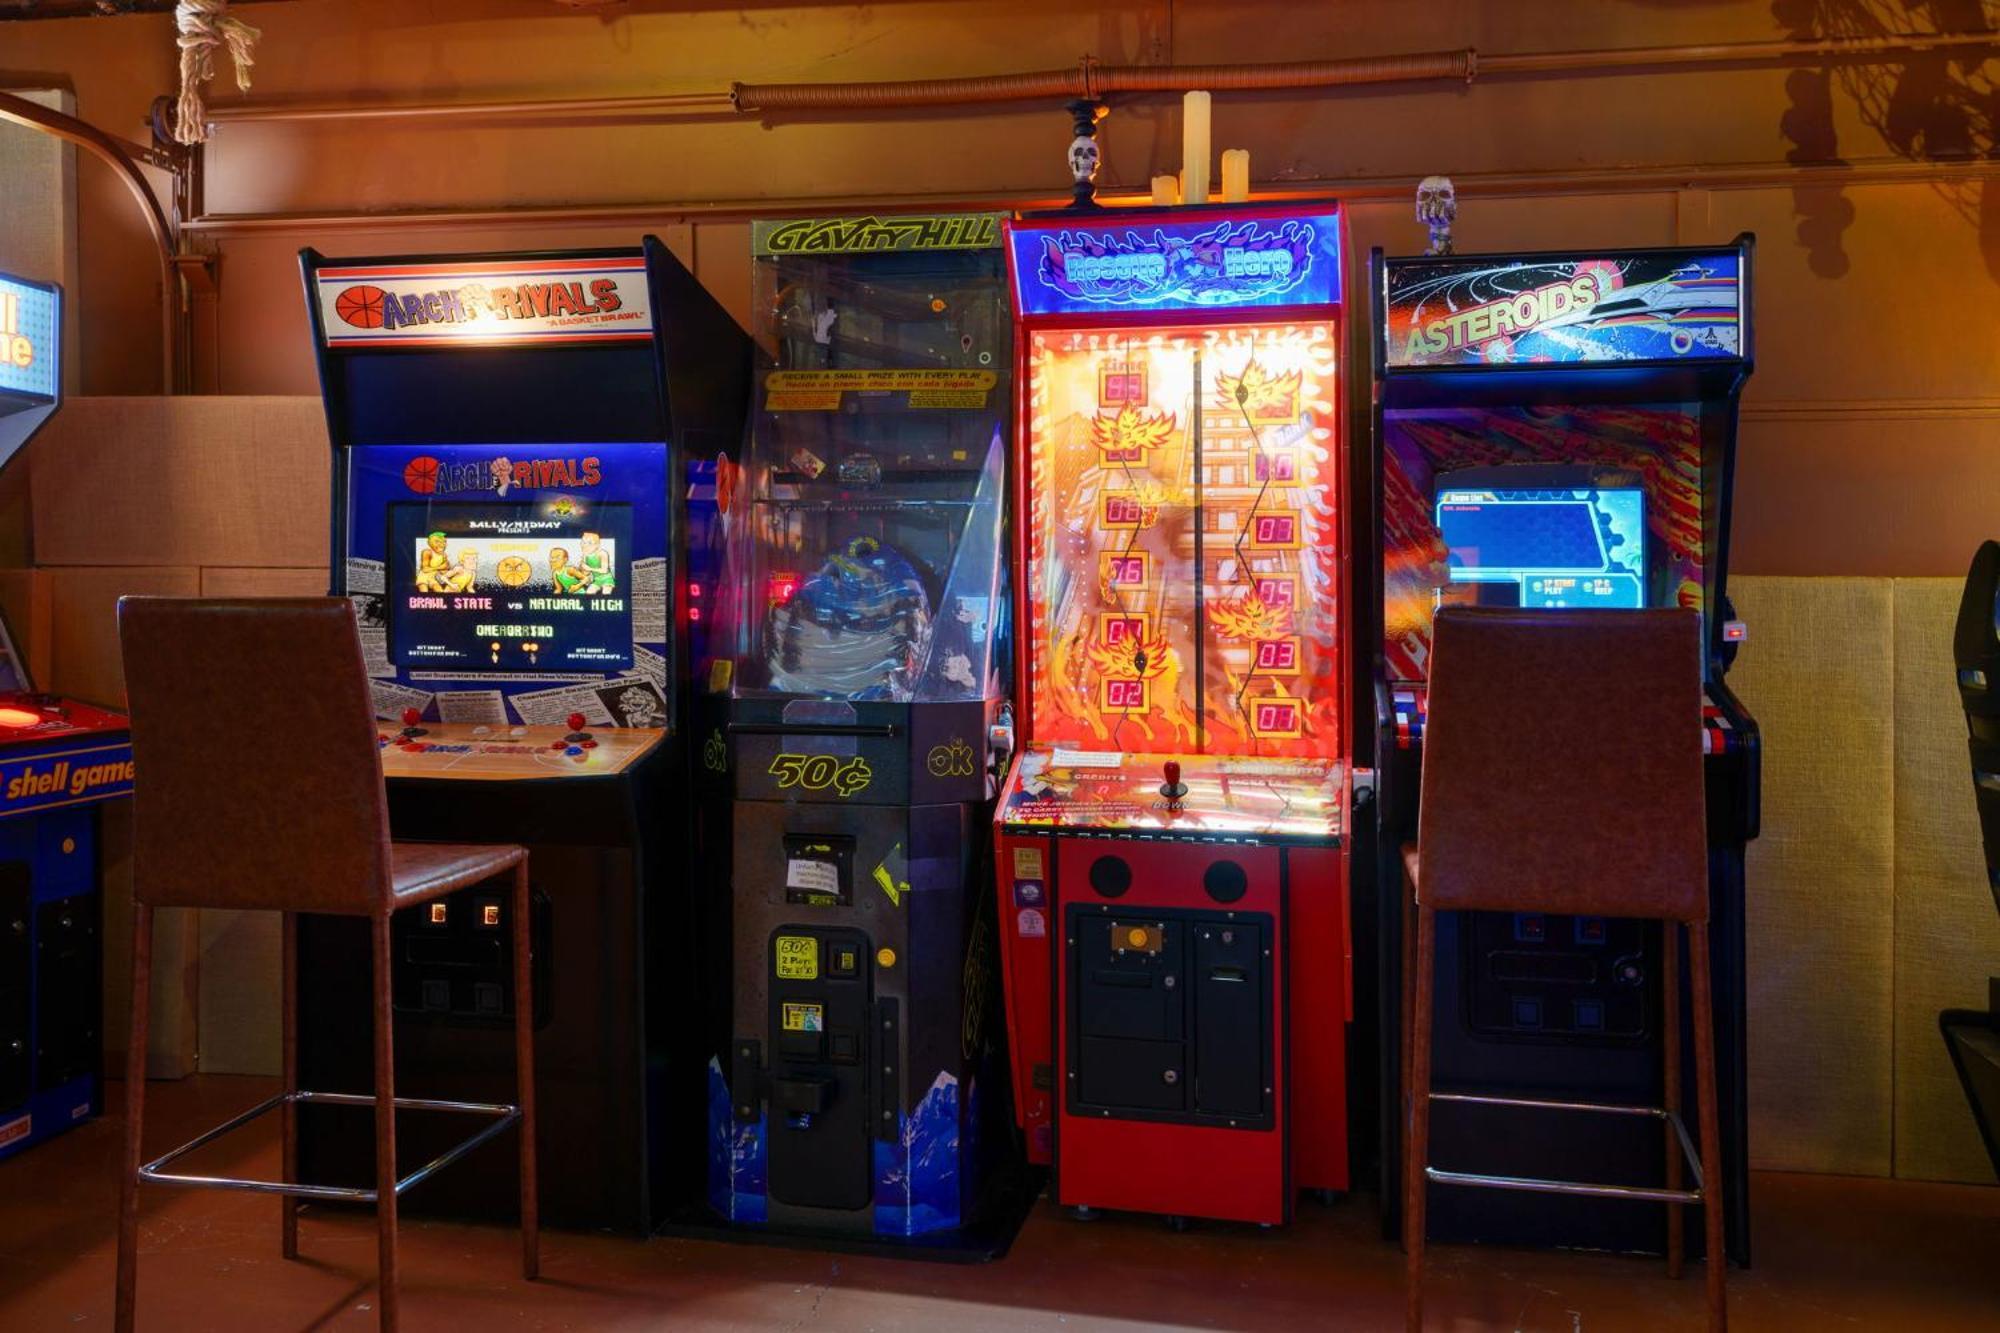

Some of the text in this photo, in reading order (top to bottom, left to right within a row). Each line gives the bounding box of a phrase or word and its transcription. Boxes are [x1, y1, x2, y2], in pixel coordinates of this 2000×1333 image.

[1065, 248, 1292, 281] Rescue Hero
[381, 279, 622, 330] ARCH RIVALS
[1406, 273, 1601, 356] ASTEROIDS
[435, 456, 601, 495] ARCH RIVALS
[1258, 518, 1293, 542] 07
[409, 597, 447, 609] BRAWL
[454, 598, 492, 609] STATE
[529, 598, 584, 611] NATURAL
[591, 600, 623, 611] HIGH
[1259, 644, 1293, 667] 03
[1109, 683, 1142, 705] 02
[1259, 707, 1294, 730] 01
[768, 754, 872, 796] 50¢
[928, 746, 974, 776] OK
[6, 762, 69, 799] shell
[1152, 801, 1191, 809] DOWN
